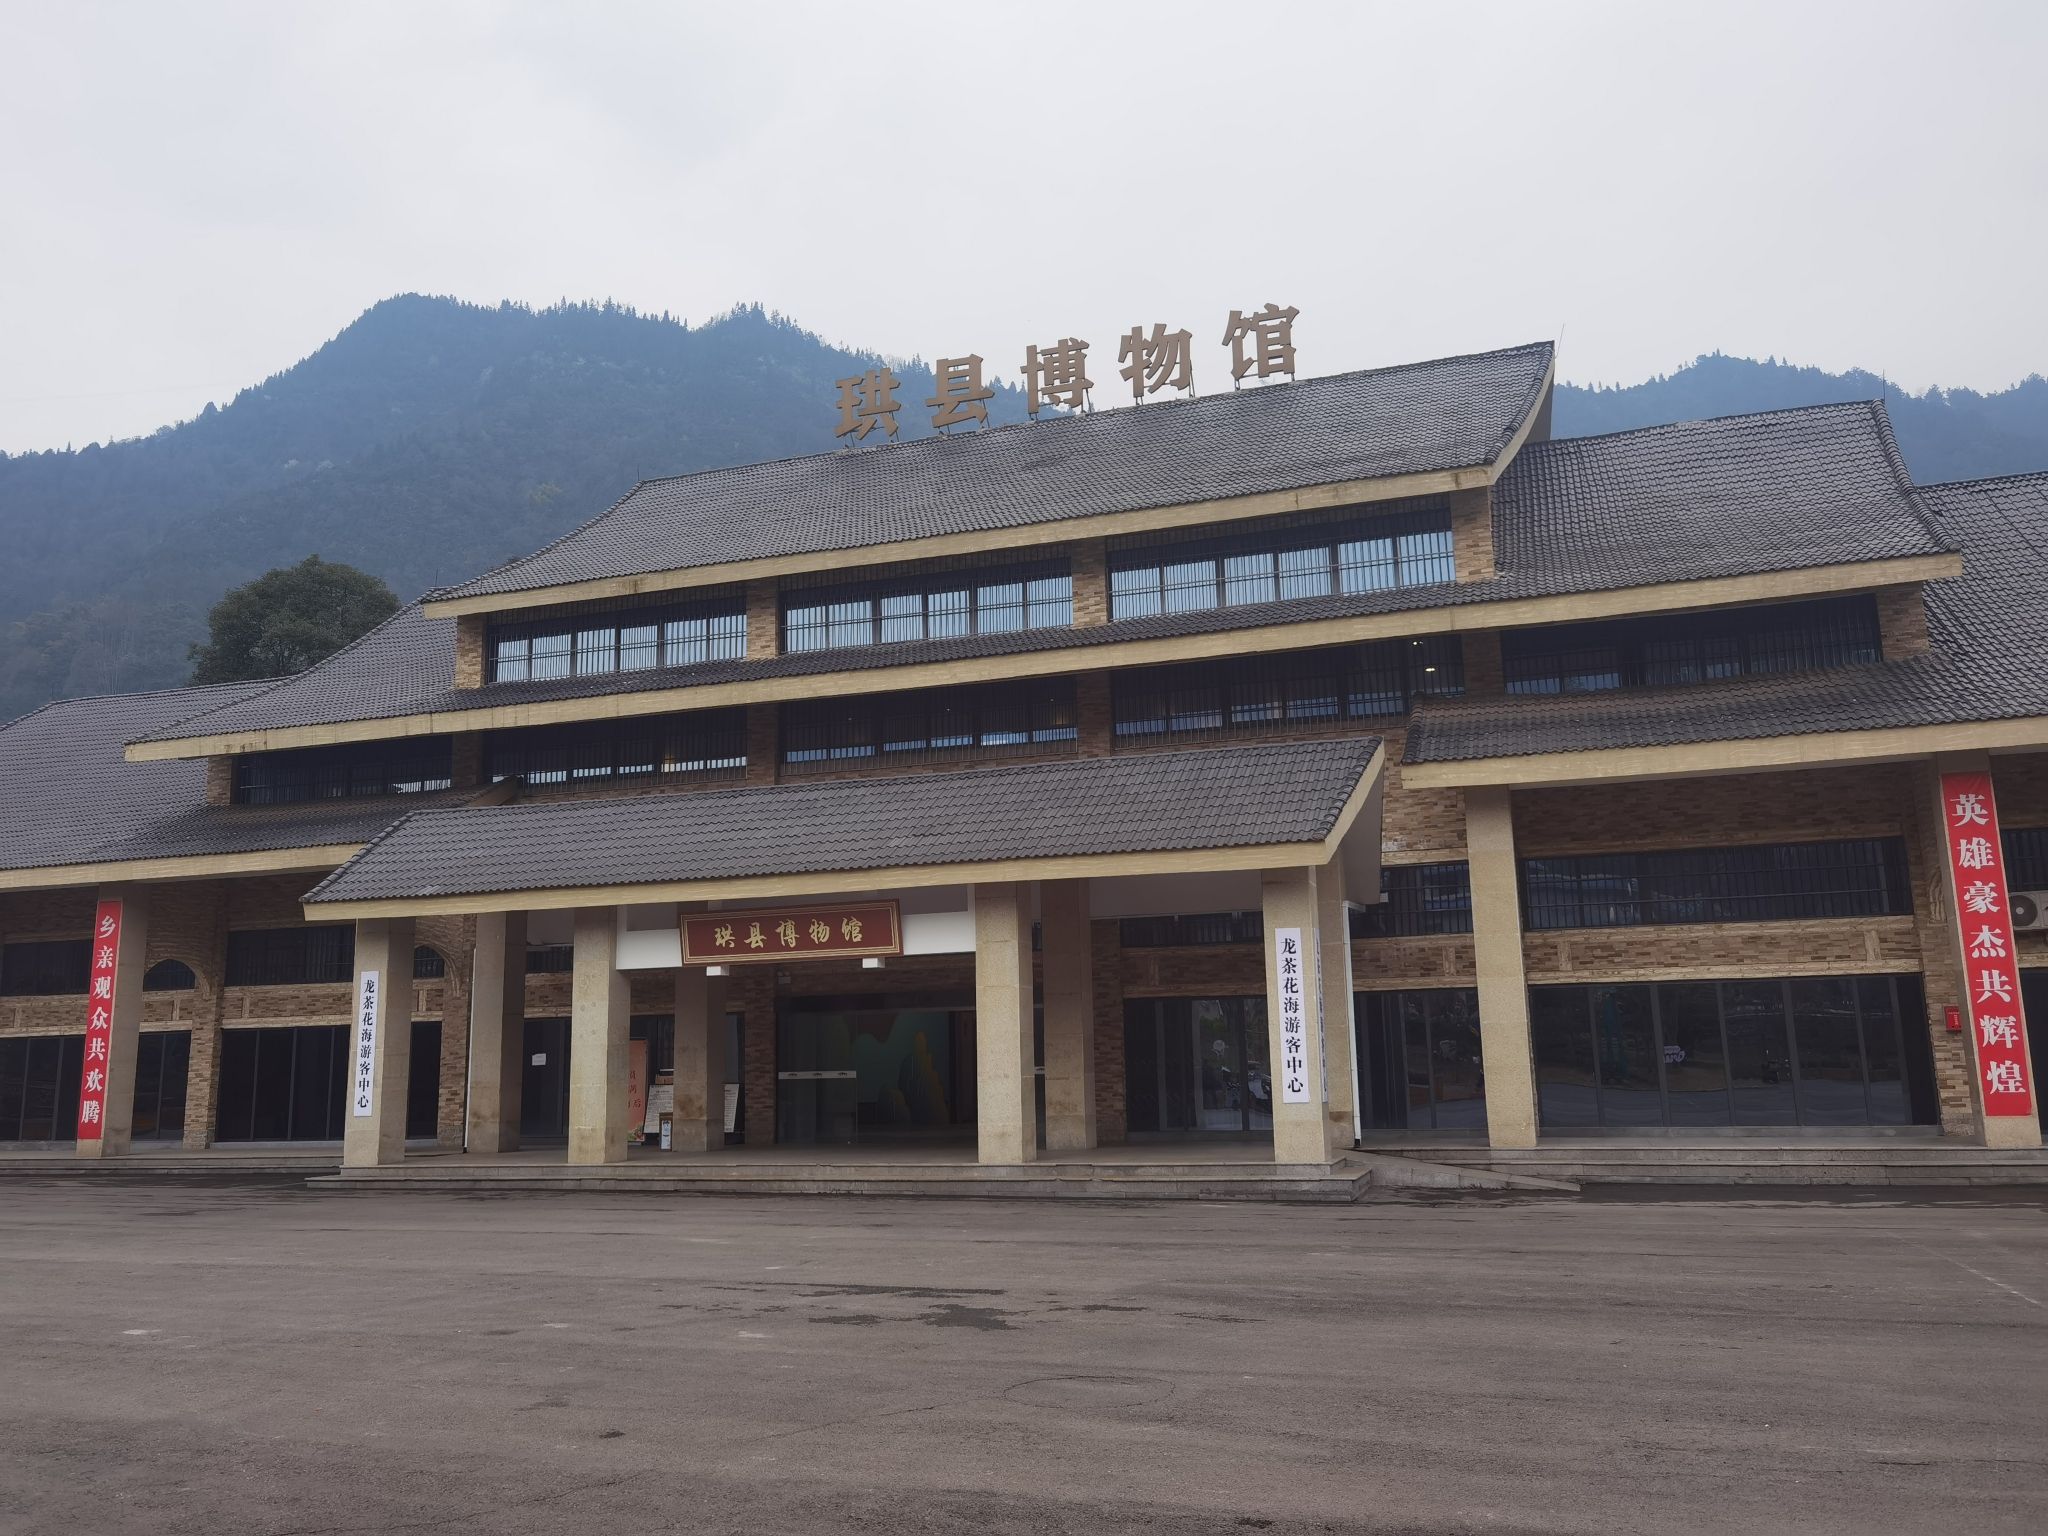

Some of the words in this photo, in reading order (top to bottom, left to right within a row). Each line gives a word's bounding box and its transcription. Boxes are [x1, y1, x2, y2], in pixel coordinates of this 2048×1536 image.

[833, 303, 1300, 440] 珙县博物馆
[714, 915, 864, 949] 珙县博物馆
[1950, 793, 2026, 1094] 英雄豪杰共辉煌
[81, 915, 116, 1124] 乡亲观众共欢腾
[357, 979, 375, 1108] 龙茶花海游客中心
[1280, 938, 1304, 1093] 龙茶花海游客中心
